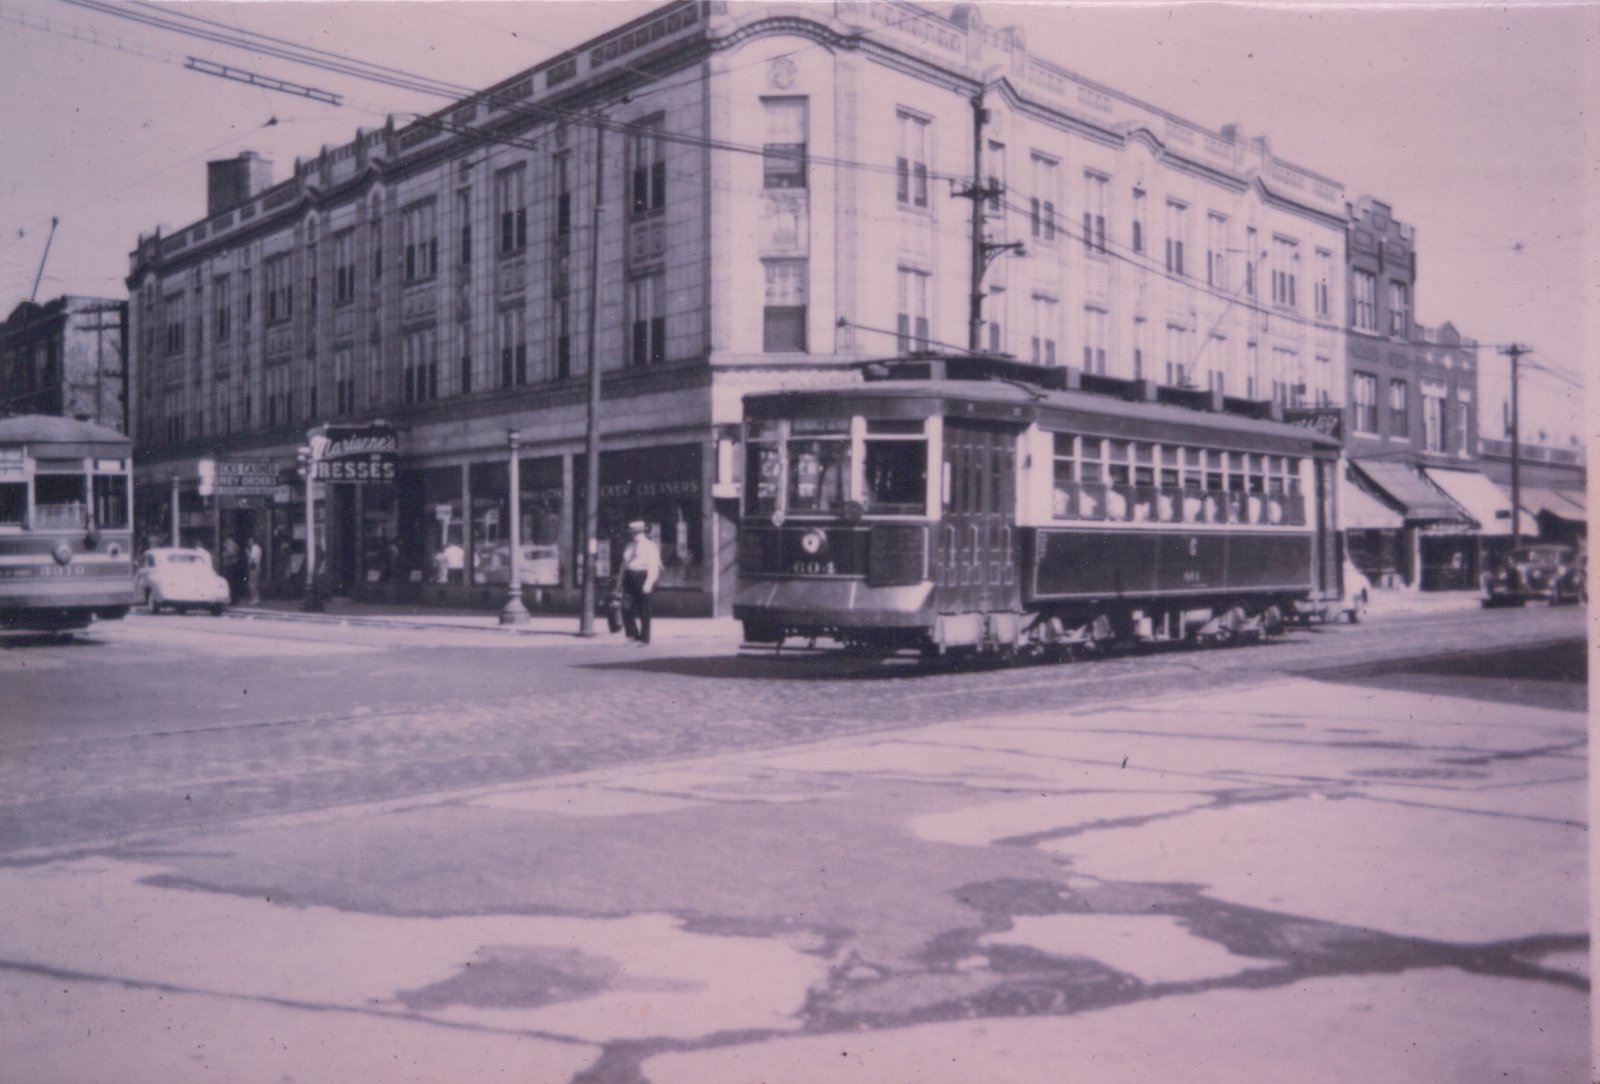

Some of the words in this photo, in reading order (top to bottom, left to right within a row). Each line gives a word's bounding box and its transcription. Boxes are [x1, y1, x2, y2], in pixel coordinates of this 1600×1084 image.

[580, 485, 630, 497] CCKER
[636, 481, 698, 495] CLEANERS
[793, 561, 836, 575] 604
